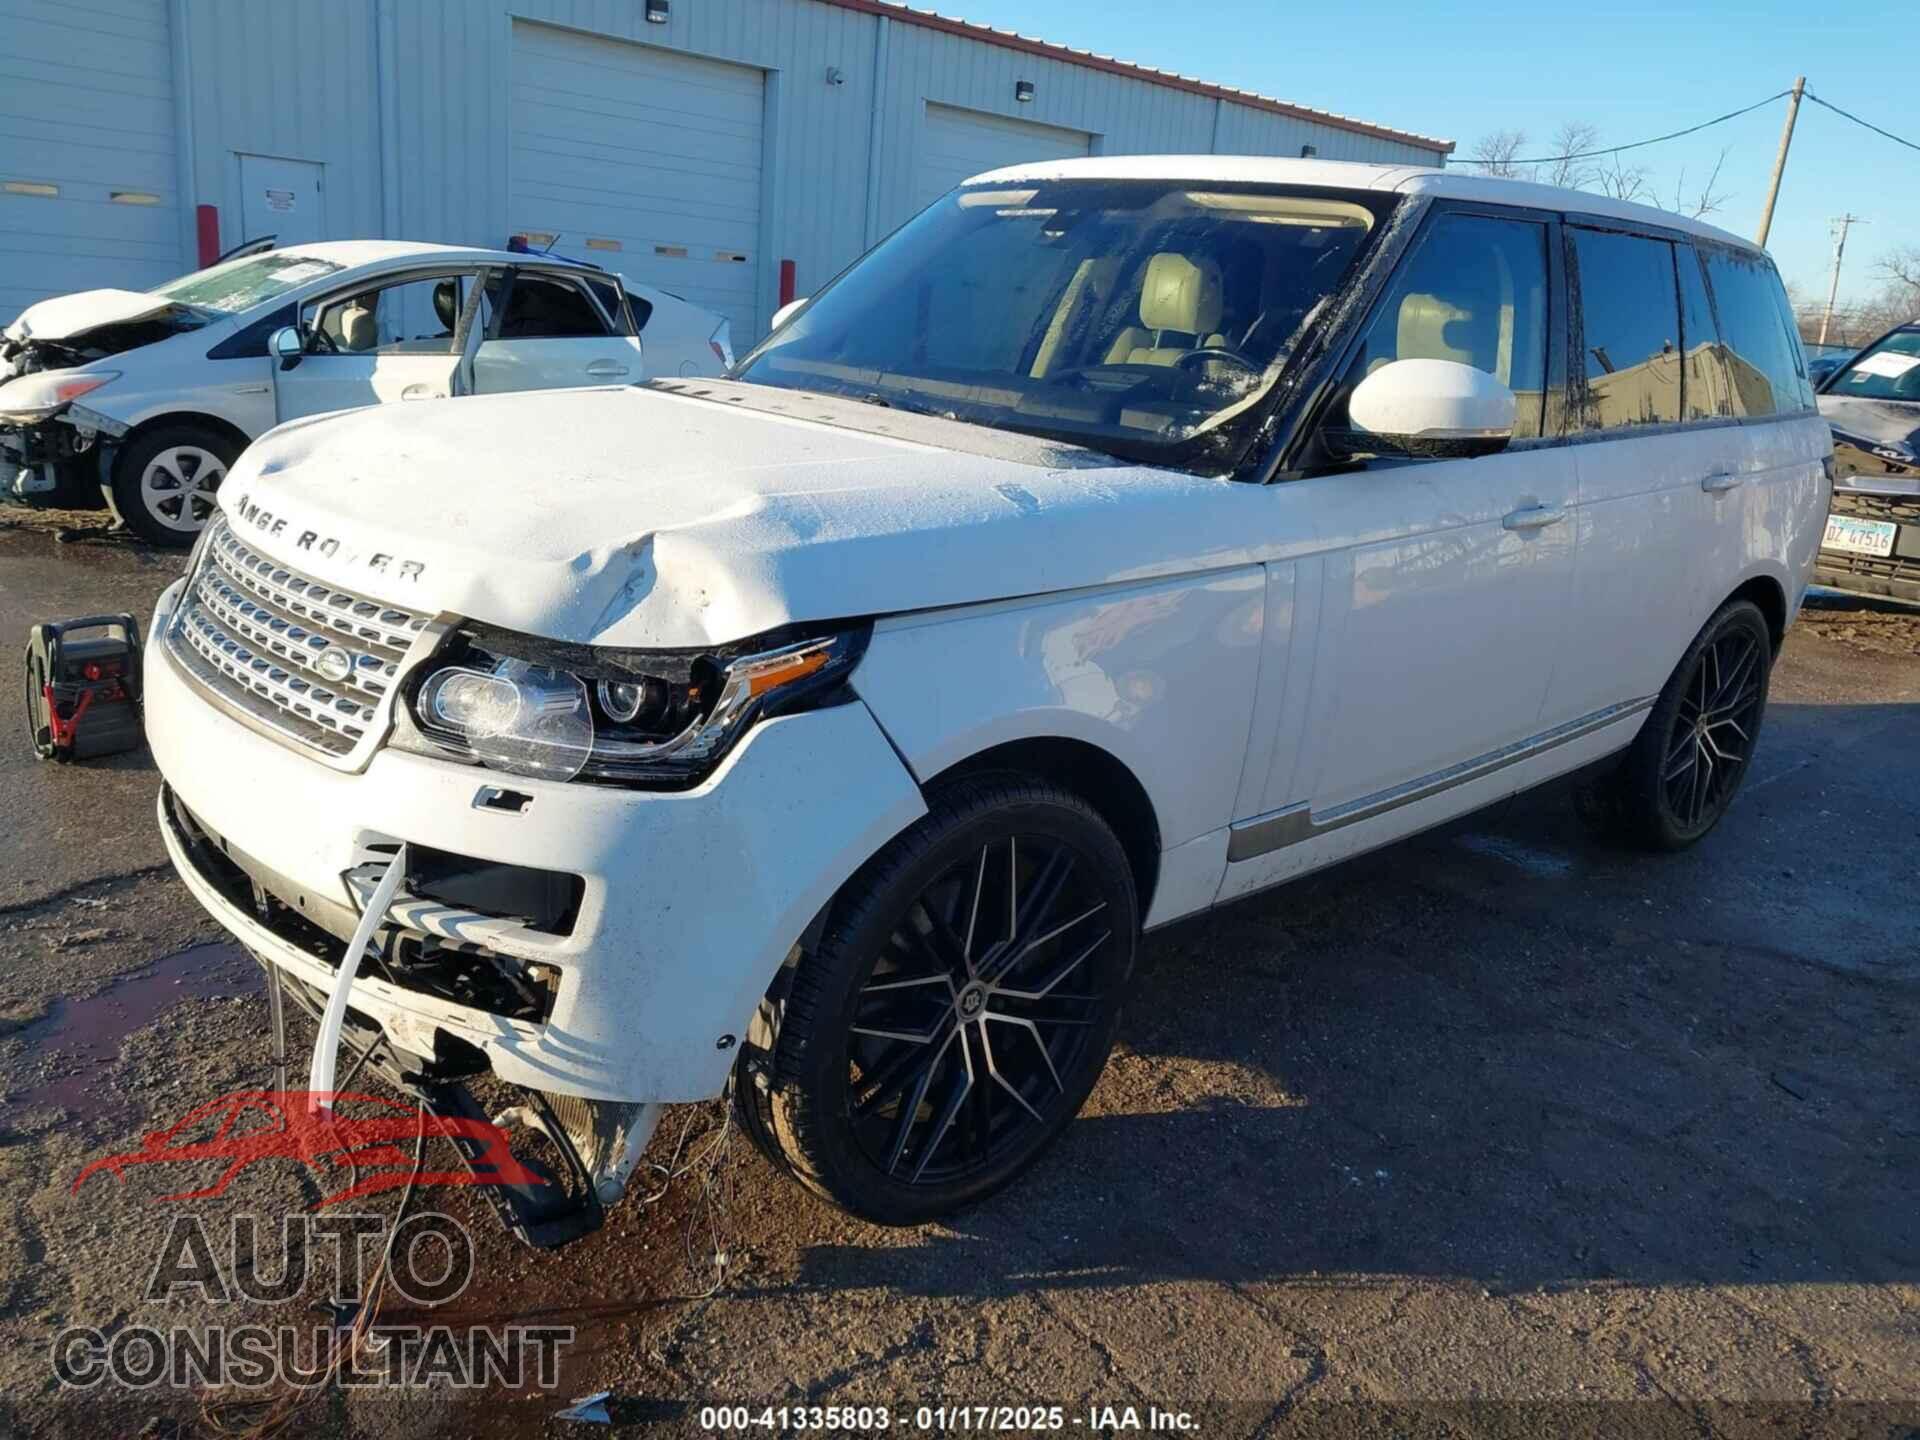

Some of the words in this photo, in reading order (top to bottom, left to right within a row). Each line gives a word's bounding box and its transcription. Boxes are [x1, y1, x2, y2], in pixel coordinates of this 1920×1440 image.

[234, 494, 289, 538] ANGE
[296, 530, 425, 582] ROER
[1849, 528, 1890, 549] 47516
